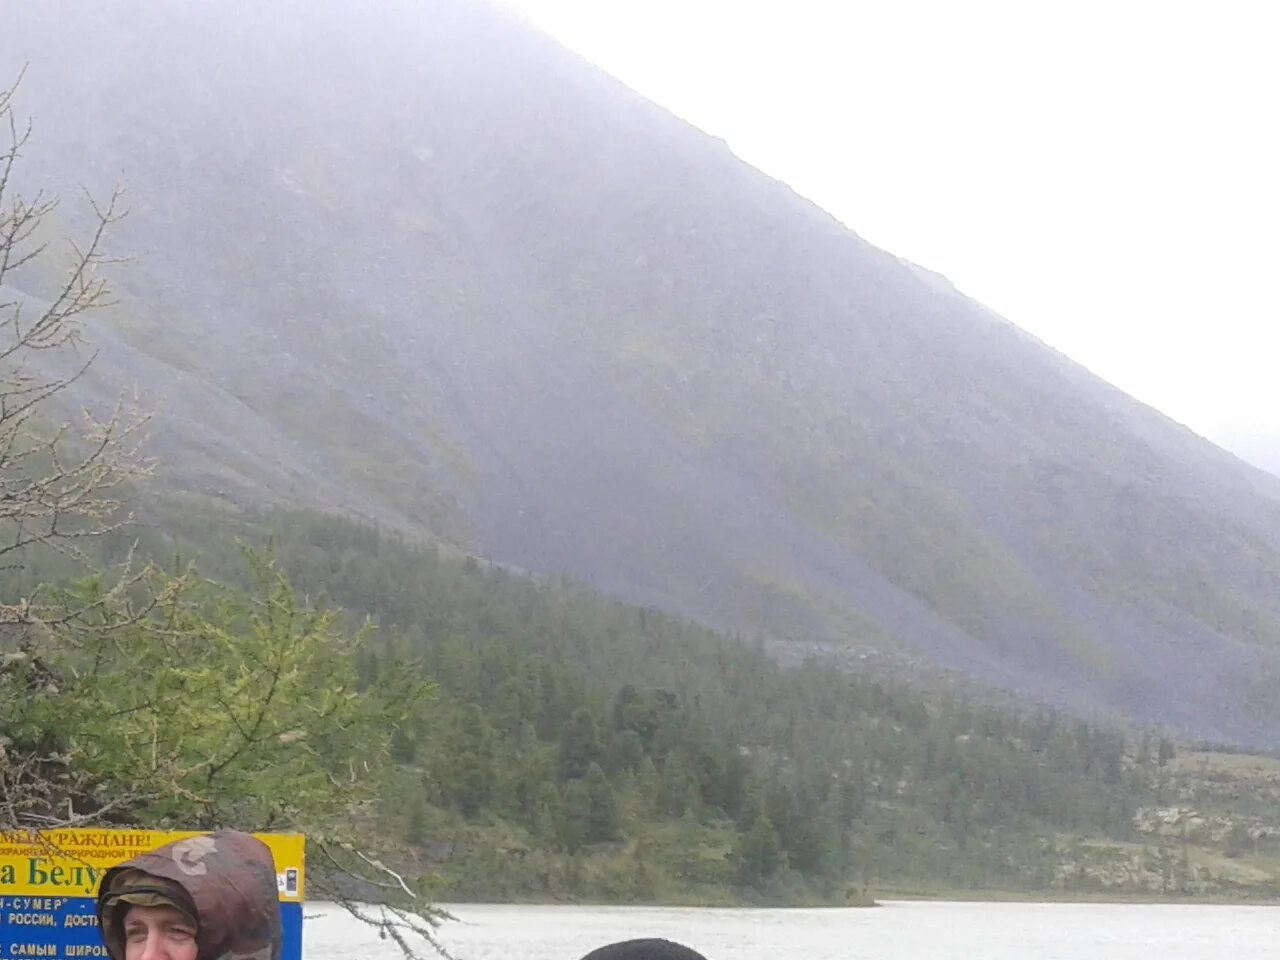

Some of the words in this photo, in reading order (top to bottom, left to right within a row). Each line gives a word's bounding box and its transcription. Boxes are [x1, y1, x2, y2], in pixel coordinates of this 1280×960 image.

[28, 857, 107, 894] Белу
[9, 913, 56, 927] РОССИИ,
[10, 944, 56, 955] САМЫМ
